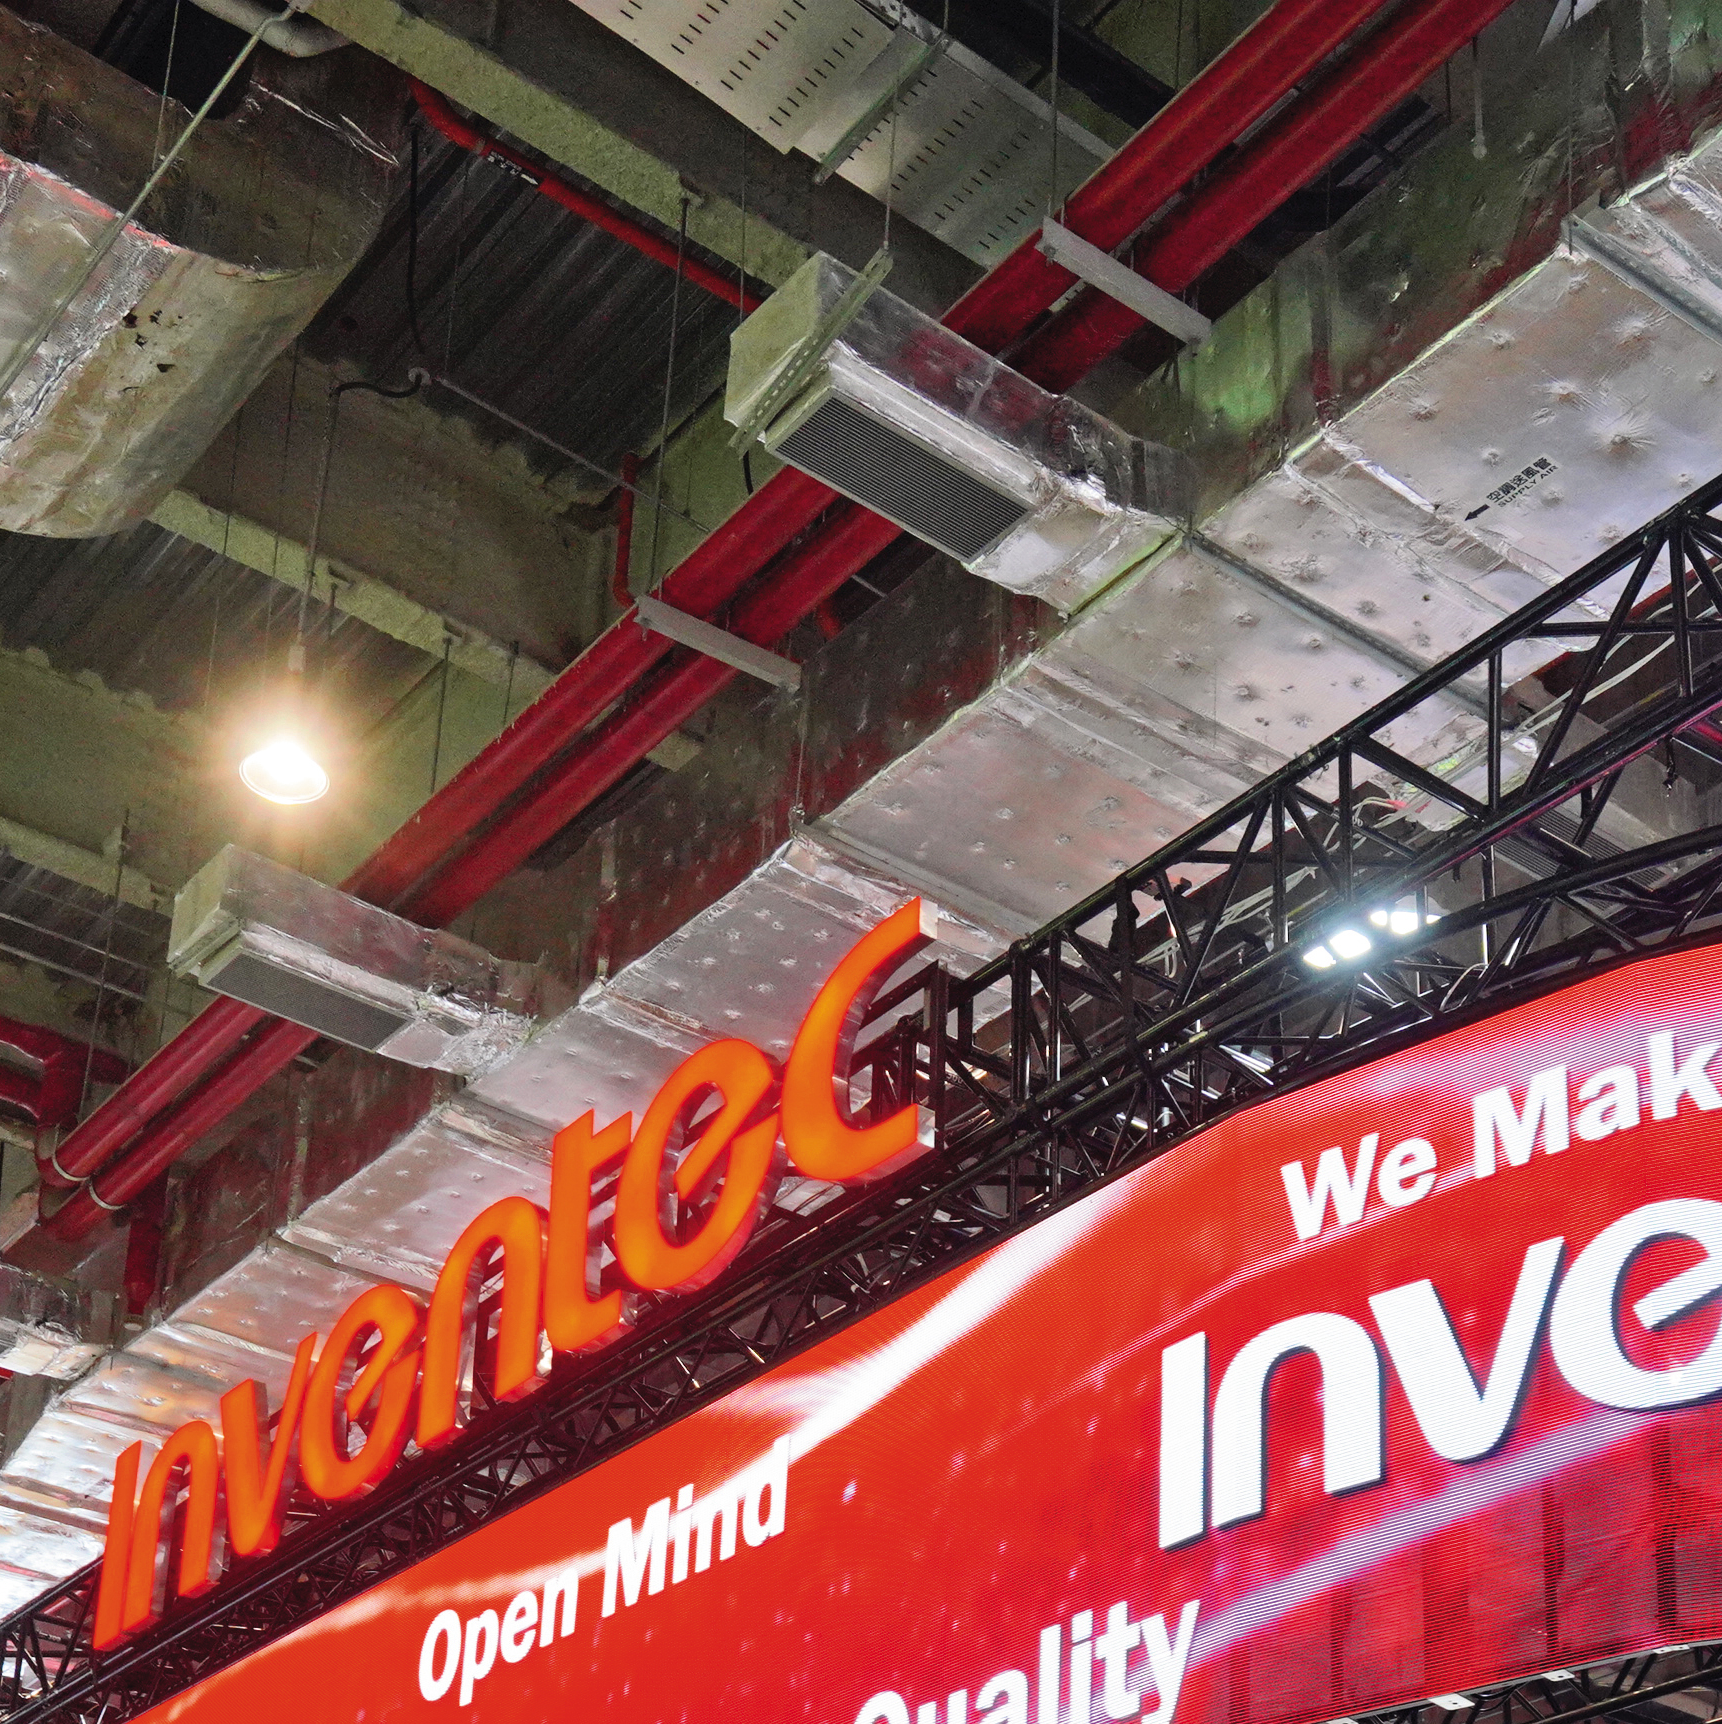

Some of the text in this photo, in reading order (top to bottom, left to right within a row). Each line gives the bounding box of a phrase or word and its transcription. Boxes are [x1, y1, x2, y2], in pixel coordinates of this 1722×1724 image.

[1497, 464, 1559, 508] SUPPLY AIR
[93, 896, 927, 1652] Inventec
[1280, 1130, 1437, 1240] We
[417, 1434, 791, 1708] Open Mind
